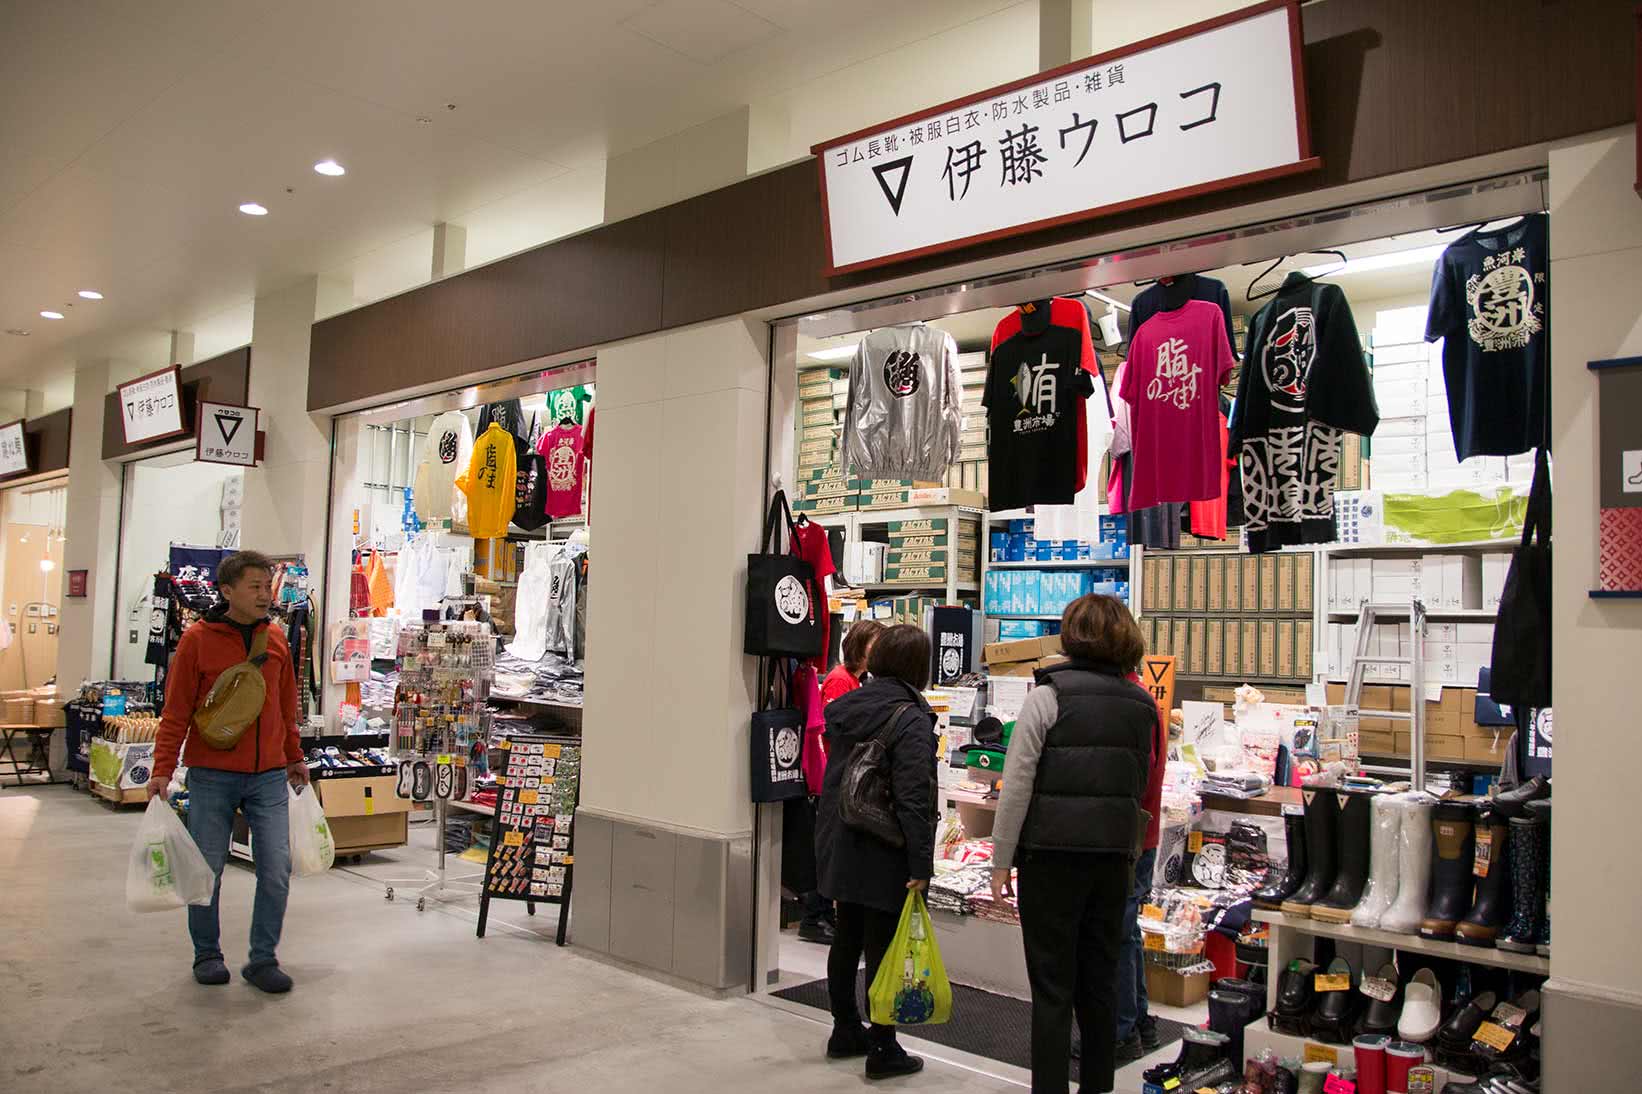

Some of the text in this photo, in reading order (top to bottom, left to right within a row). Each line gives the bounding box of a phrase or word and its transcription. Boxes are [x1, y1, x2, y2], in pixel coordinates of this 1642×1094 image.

[941, 81, 1222, 201] 伊藤ウロコ
[1482, 247, 1526, 271] 魚河岸
[1013, 413, 1055, 432] 豊洲市場
[205, 447, 249, 460] 伊藤ウロコ
[871, 493, 901, 503] ZACTAS
[901, 520, 932, 530] ZACTAS
[903, 536, 934, 546] ZACTAS
[901, 551, 931, 561] ZACTAS
[899, 567, 929, 577] ZACTAS
